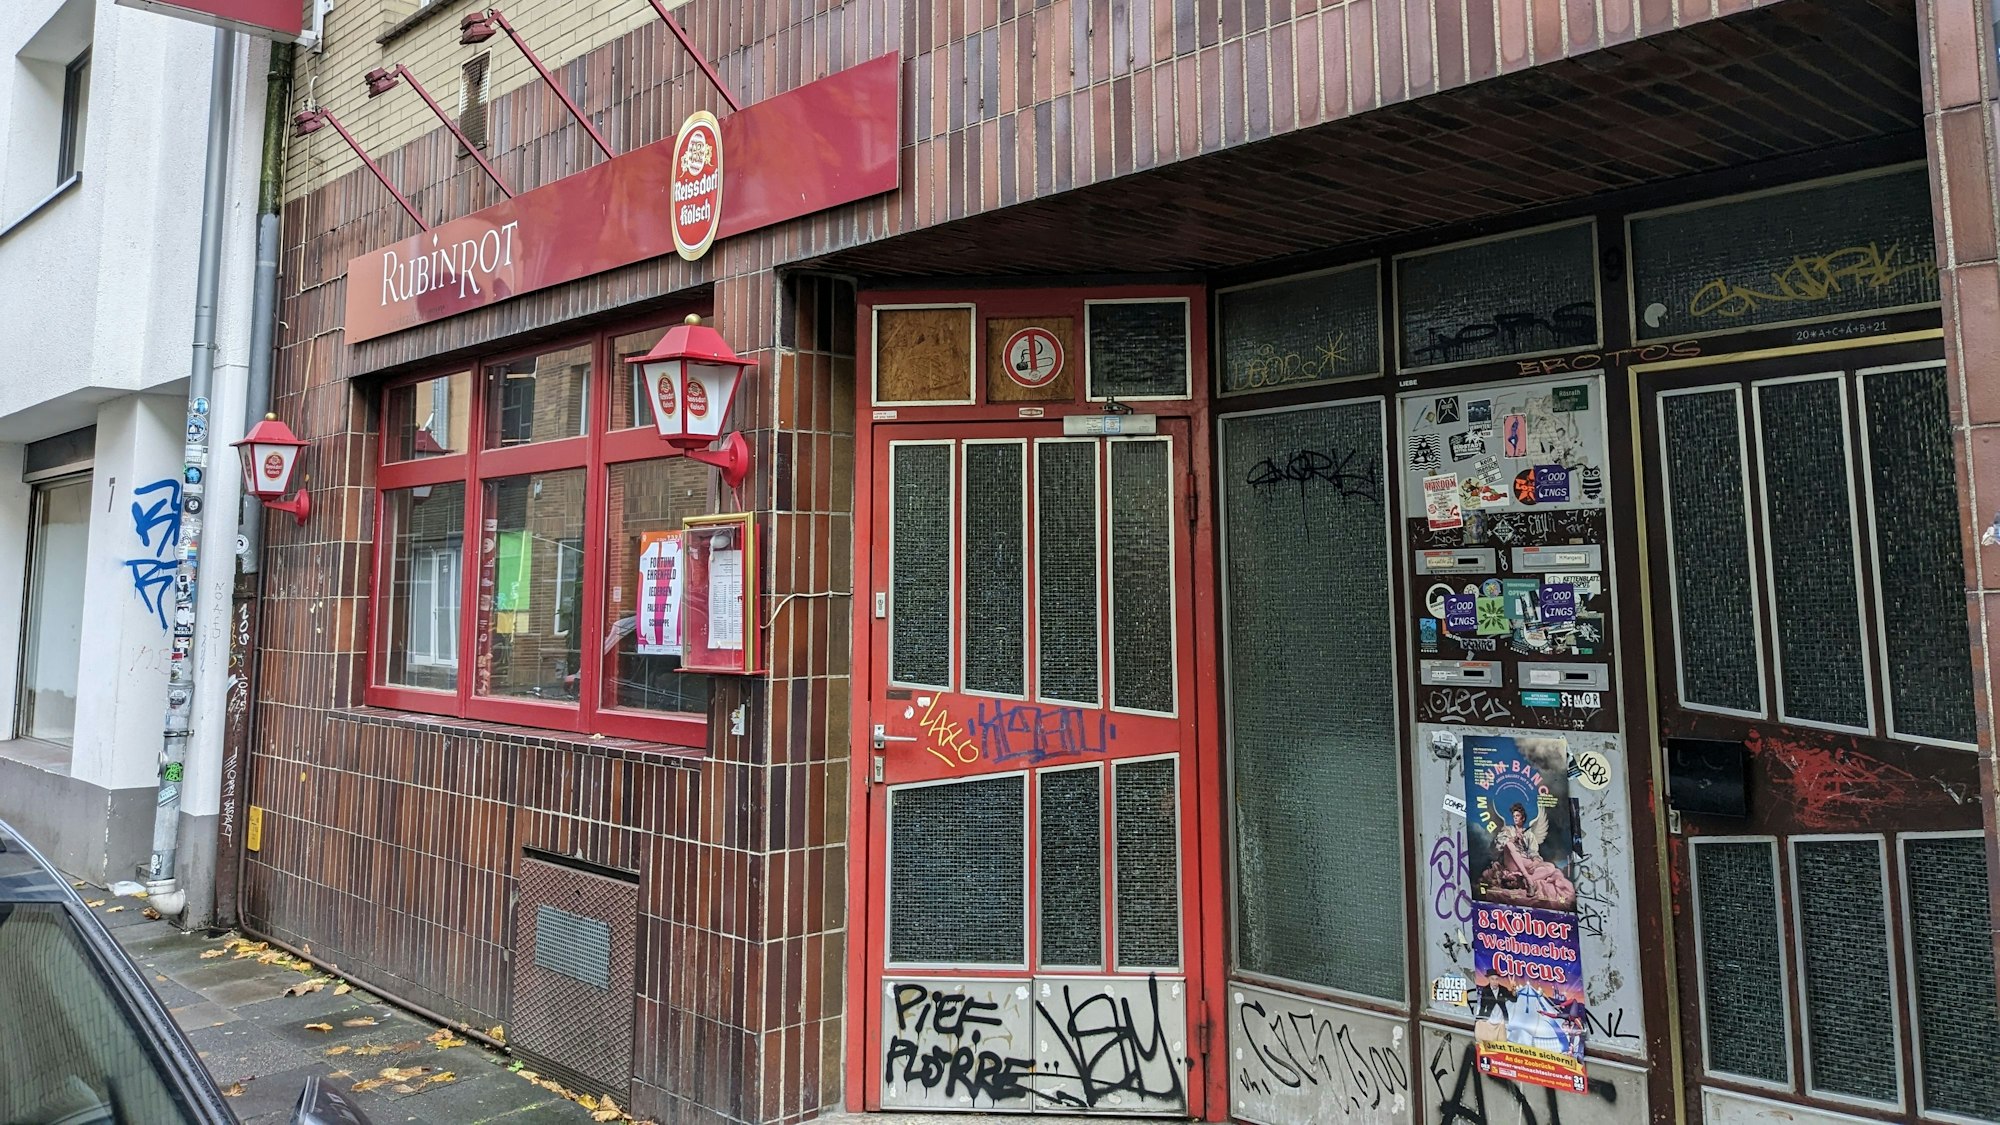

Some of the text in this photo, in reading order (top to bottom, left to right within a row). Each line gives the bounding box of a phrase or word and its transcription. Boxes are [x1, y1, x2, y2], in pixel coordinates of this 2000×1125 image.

[674, 168, 718, 203] Reissdorf
[680, 198, 711, 226] Kölsch
[1478, 932, 1577, 962] Weihnachts
[1492, 951, 1567, 983] Circus
[1436, 988, 1463, 1002] GEIST
[1486, 1042, 1574, 1067] Jetzt Tickets sichern!
[1573, 1075, 1584, 1084] 31
